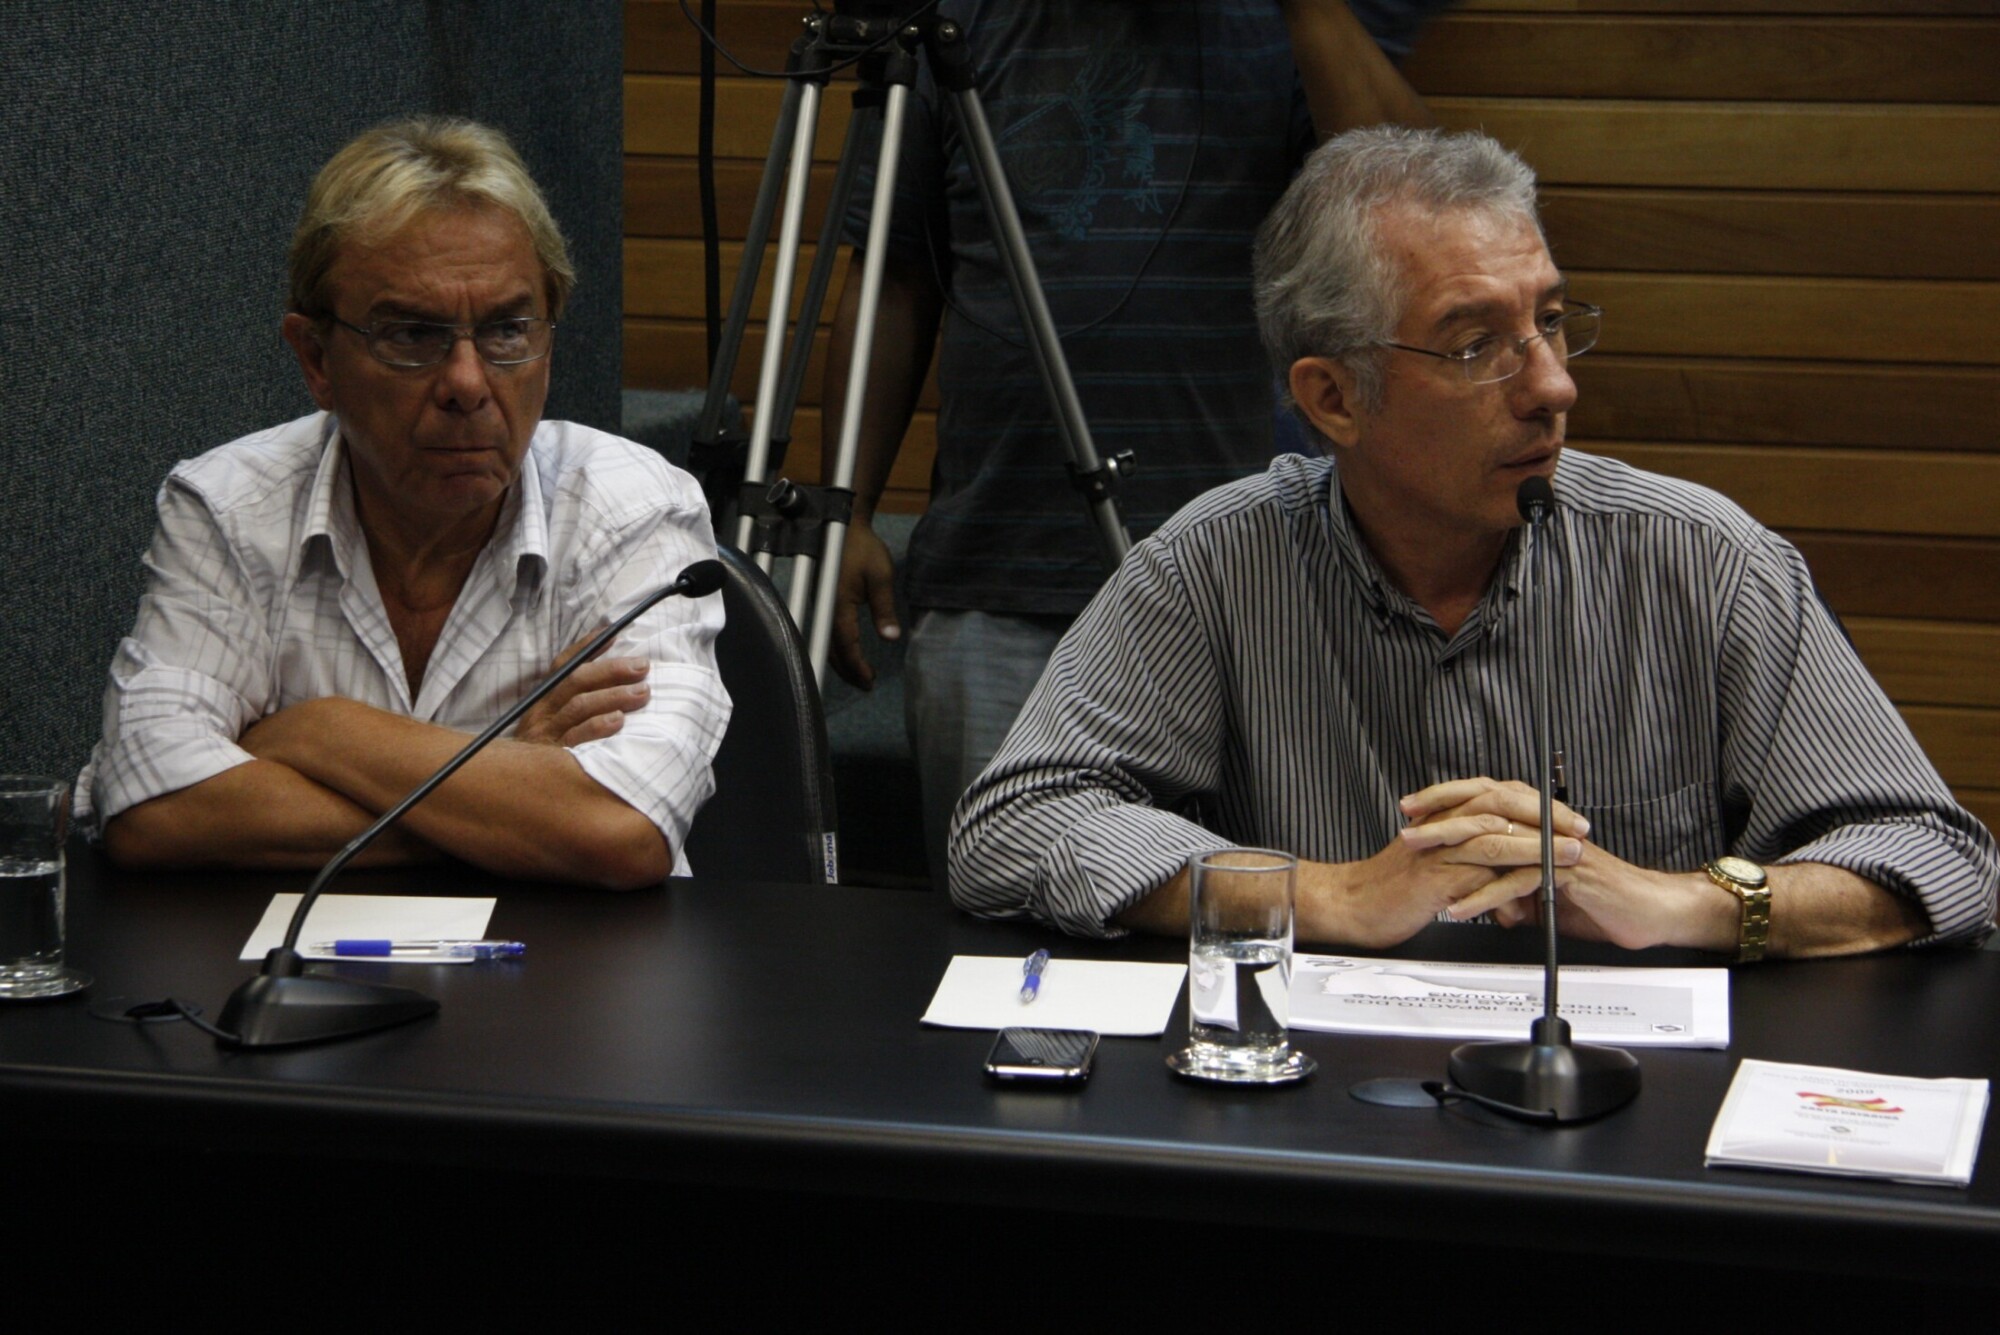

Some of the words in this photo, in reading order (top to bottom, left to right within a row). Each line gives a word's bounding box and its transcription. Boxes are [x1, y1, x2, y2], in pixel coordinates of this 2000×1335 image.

[1352, 993, 1469, 1003] RODOVIAS
[1427, 991, 1540, 1001] STADUAIS
[1343, 998, 1389, 1006] DOS
[1398, 1002, 1498, 1011] IMPACTO
